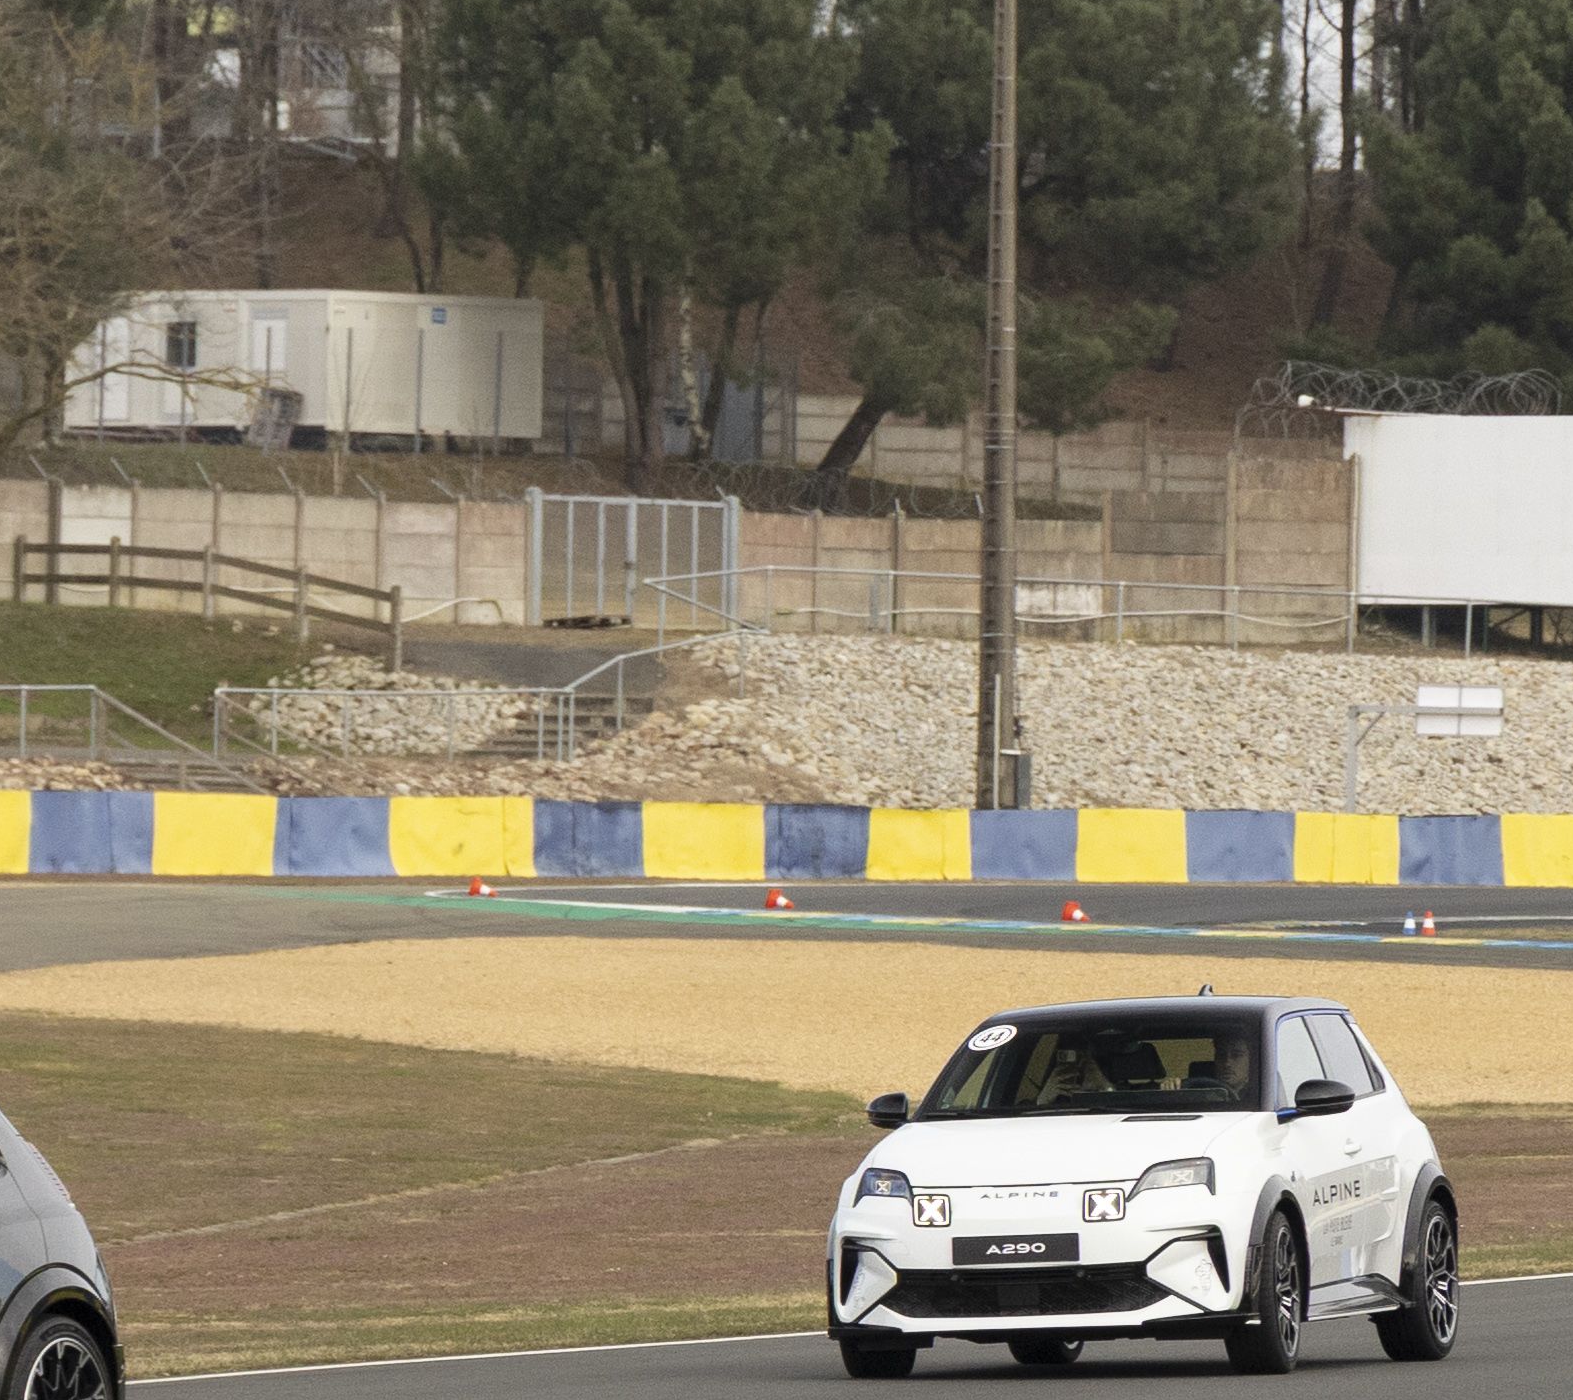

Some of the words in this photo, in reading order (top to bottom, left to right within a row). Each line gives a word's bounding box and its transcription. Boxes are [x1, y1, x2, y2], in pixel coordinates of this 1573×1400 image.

[980, 1032, 1005, 1042] 44
[980, 1191, 1059, 1199] ALPINE
[1312, 1180, 1361, 1207] ALPINE
[985, 1242, 1046, 1255] A290
